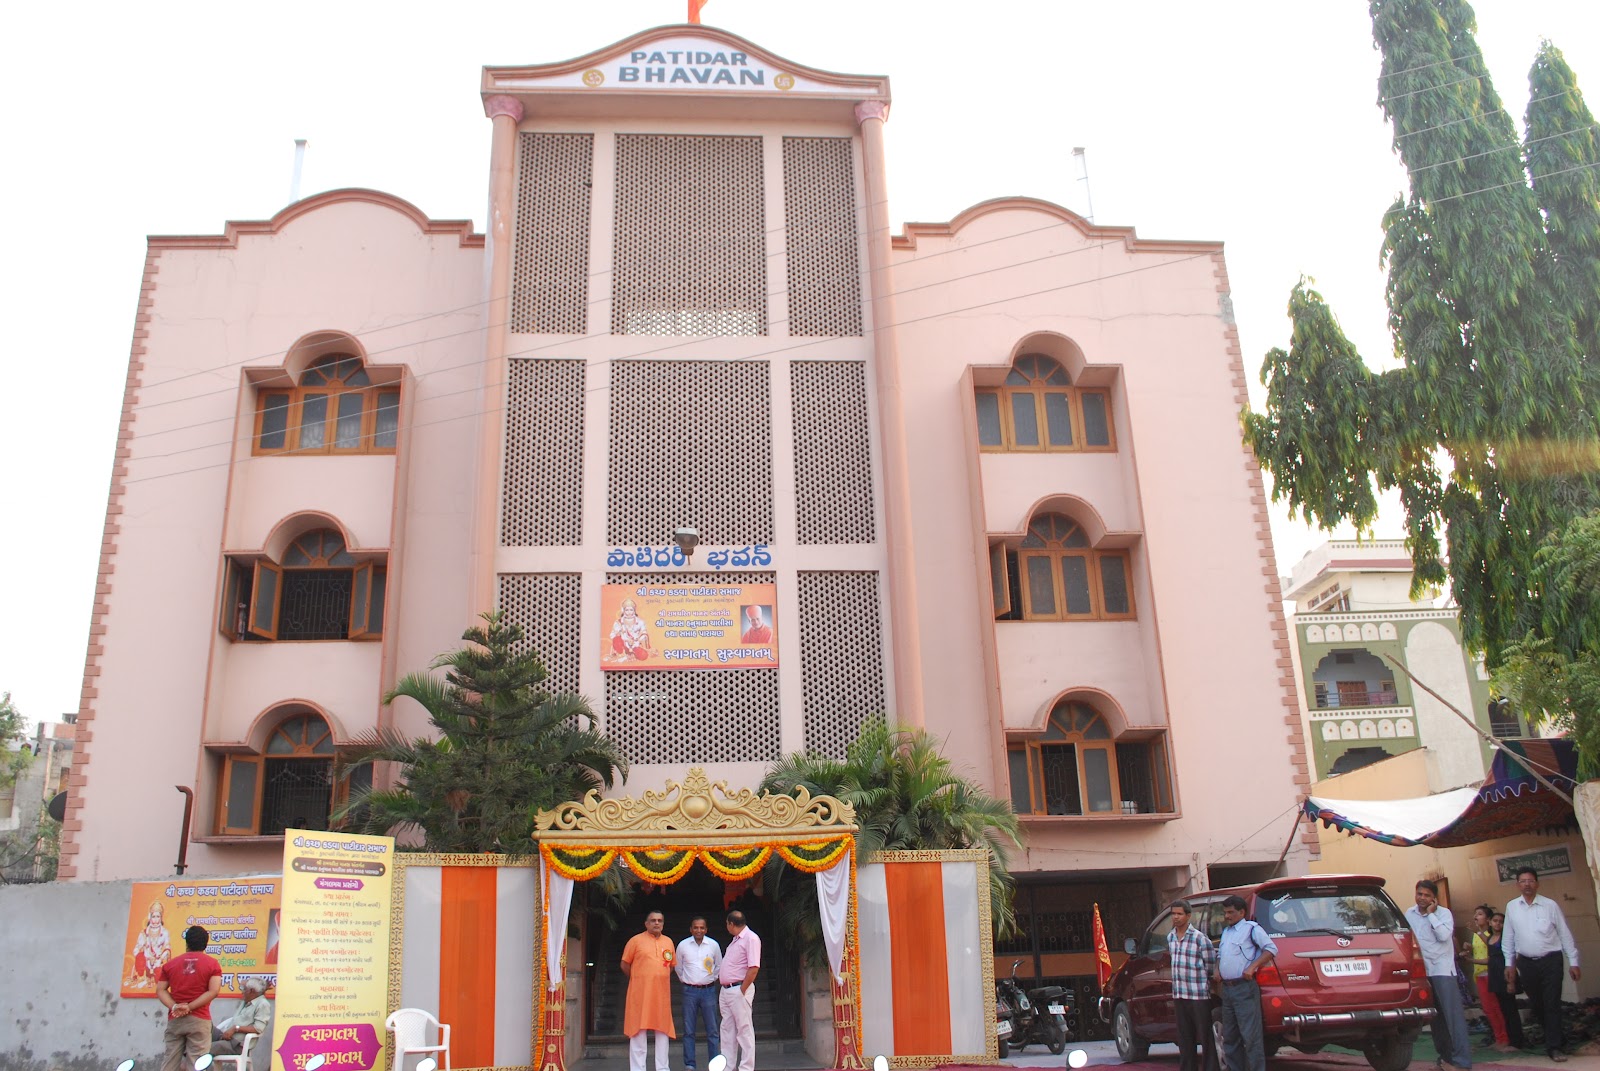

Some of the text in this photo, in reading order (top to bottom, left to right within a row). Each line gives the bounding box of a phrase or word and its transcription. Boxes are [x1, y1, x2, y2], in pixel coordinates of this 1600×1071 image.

[630, 51, 748, 66] PATIDAR
[618, 66, 765, 86] BHAVAN
[707, 544, 772, 570] భవన్
[636, 586, 647, 596] શ્રી
[649, 588, 666, 596] કచ్છ
[690, 586, 717, 596] પાટીદાર
[720, 588, 742, 596] સમાજ
[655, 618, 664, 627] શ્રી
[664, 648, 775, 662] સ્વાગતમ્ સુસ્વાગતમ્
[294, 836, 304, 847] શ્રી
[323, 841, 340, 850] કડવા
[342, 839, 365, 851] પાટીદાર
[368, 844, 387, 853] સમાજ
[165, 882, 274, 897] श्री कच्छ कडवा पाटीदार समाज
[301, 1028, 361, 1043] સ્વાગતમ્
